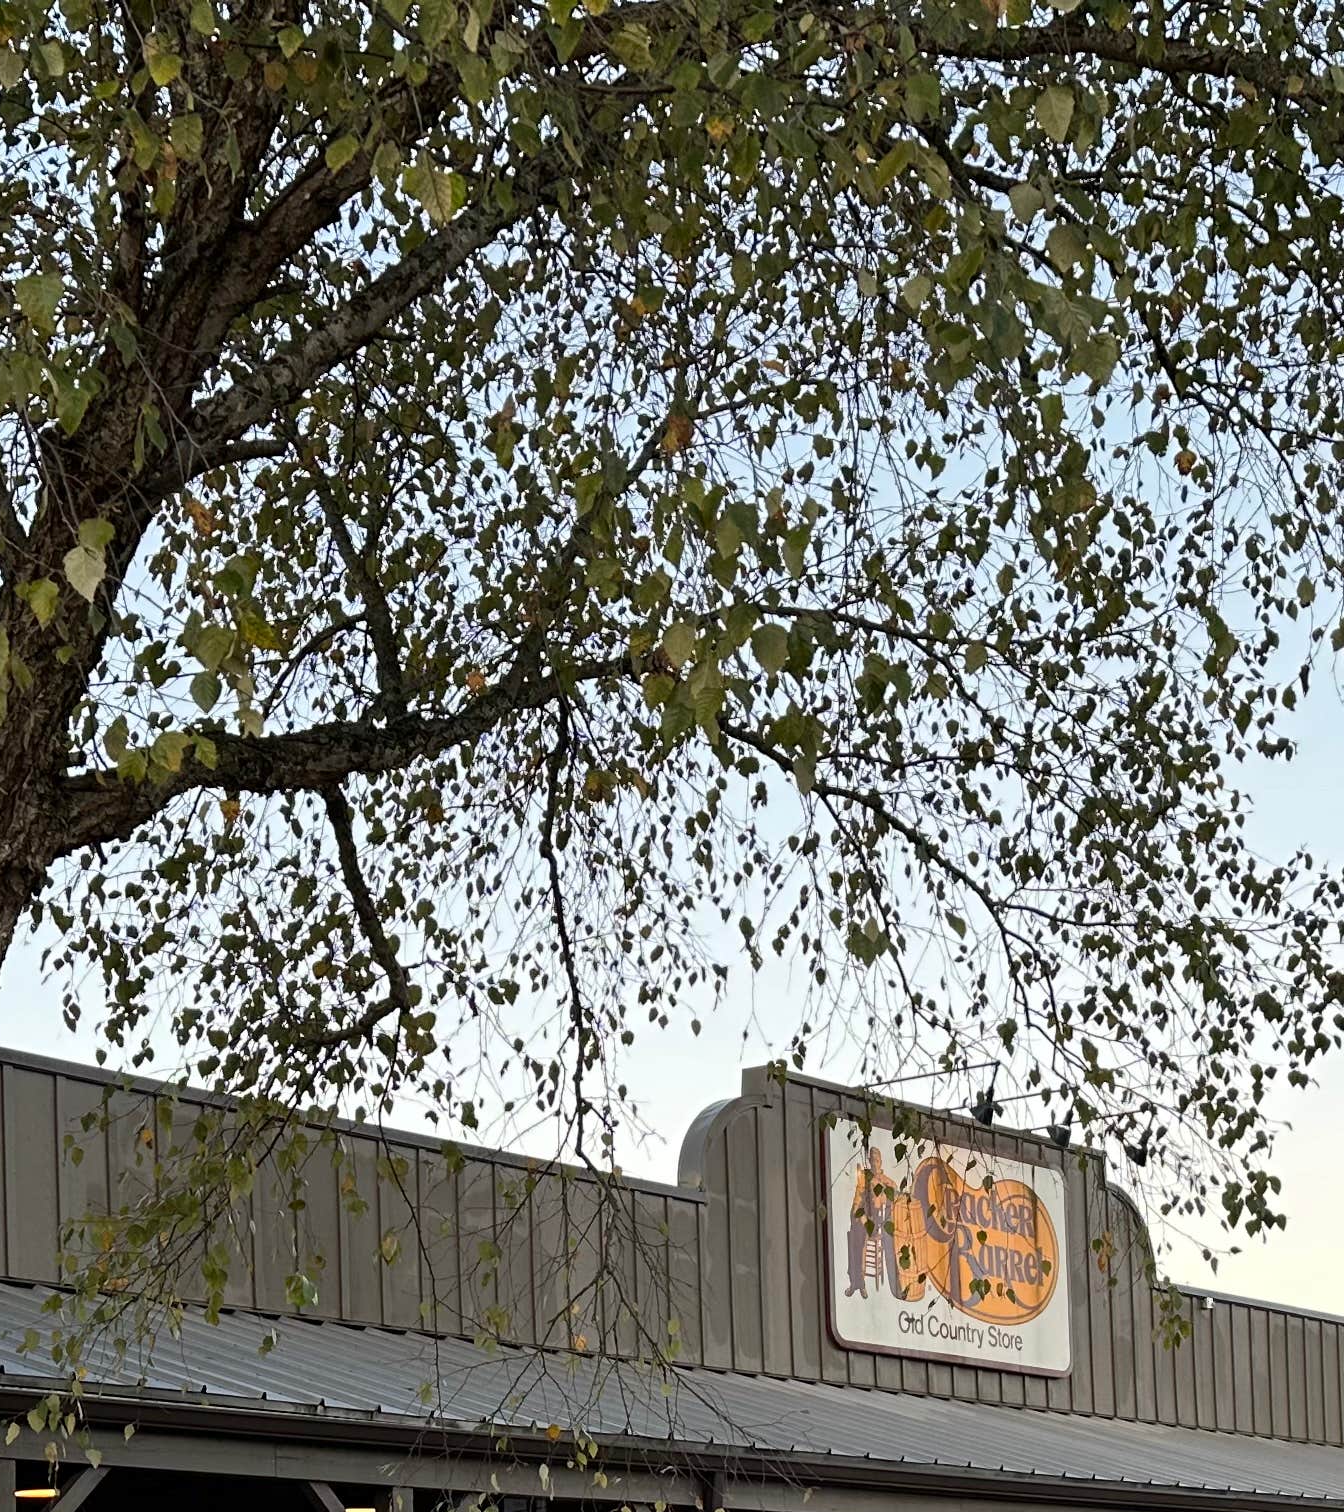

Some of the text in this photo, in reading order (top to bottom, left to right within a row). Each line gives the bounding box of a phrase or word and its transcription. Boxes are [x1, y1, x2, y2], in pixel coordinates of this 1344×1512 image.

[898, 1310, 1023, 1351] Old Country Store
